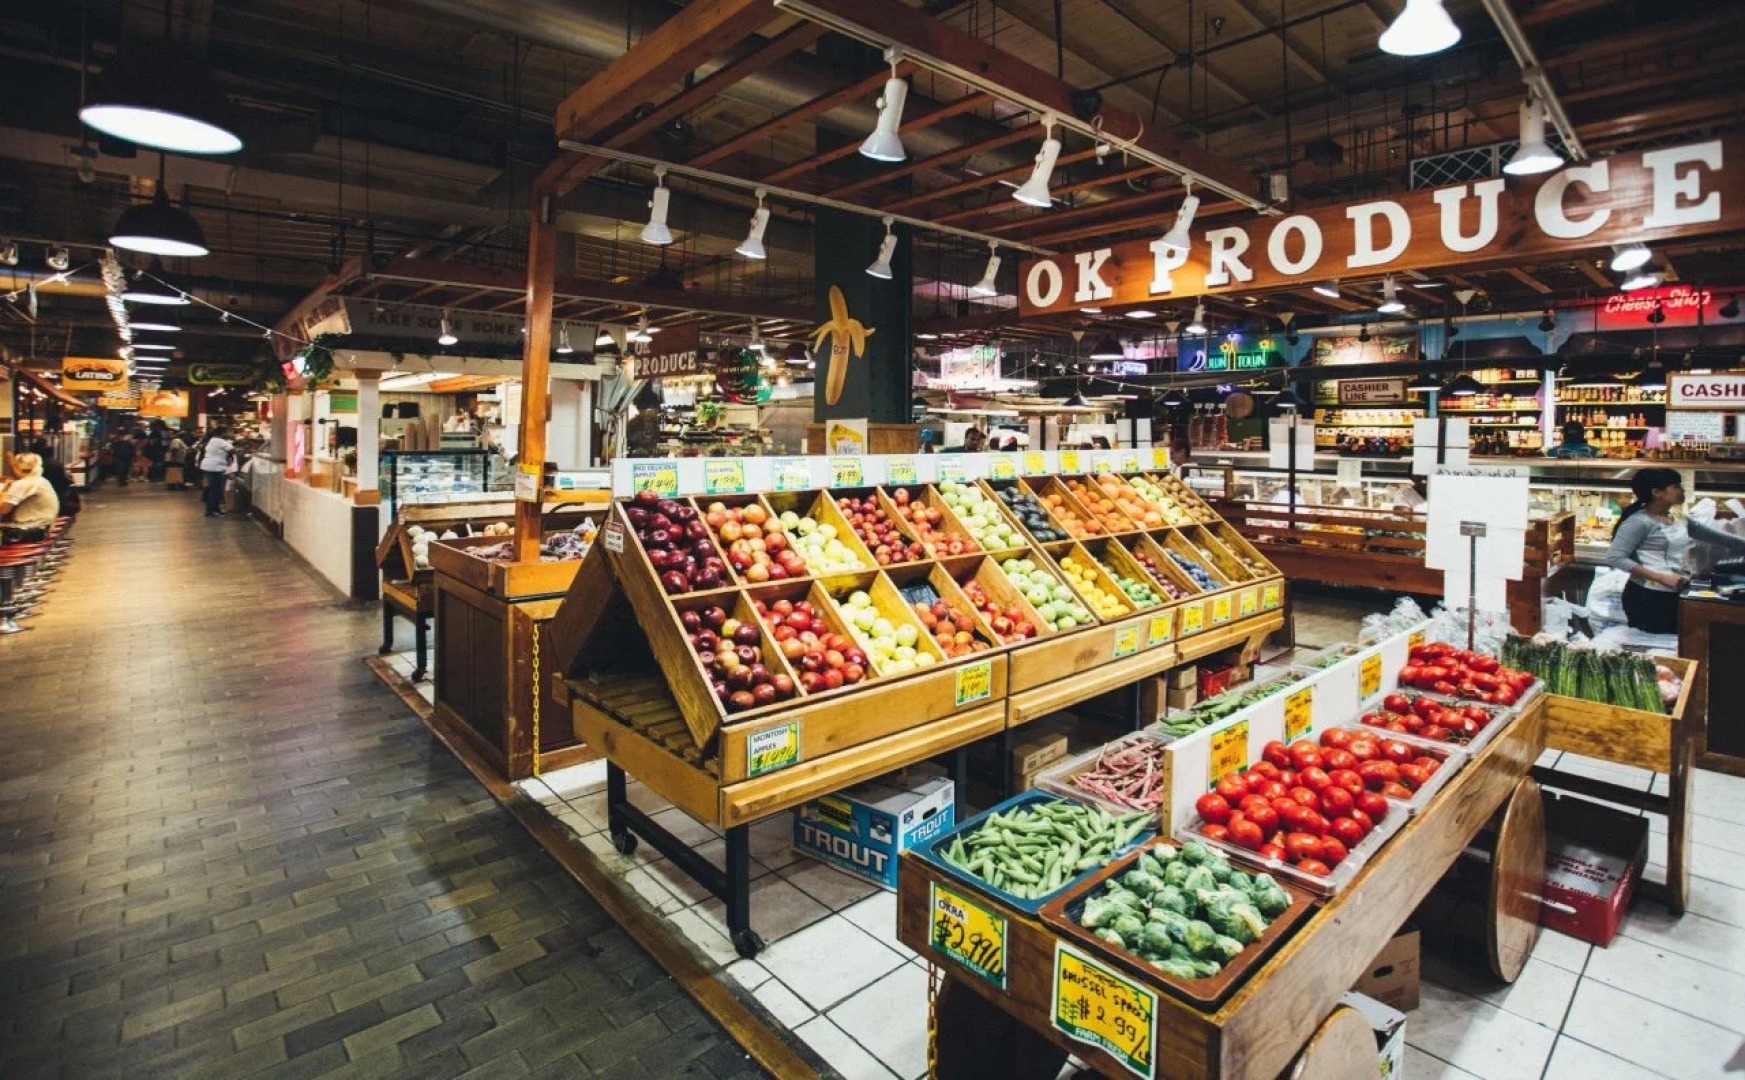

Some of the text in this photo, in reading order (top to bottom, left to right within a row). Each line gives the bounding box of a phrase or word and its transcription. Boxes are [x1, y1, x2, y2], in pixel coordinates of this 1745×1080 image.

[1026, 140, 1724, 307] OK PRODUCE
[1605, 288, 1712, 313] Cheese Shop
[368, 312, 412, 328] TAKE
[634, 351, 697, 375] PRODUCE
[1343, 382, 1389, 392] CASHIER
[1344, 392, 1368, 401] LINE
[753, 742, 777, 754] APPLES
[910, 809, 949, 843] TROUT
[800, 823, 889, 872] TROUT
[938, 898, 966, 921] OKRA
[1075, 1027, 1129, 1063] FARM FRESH
